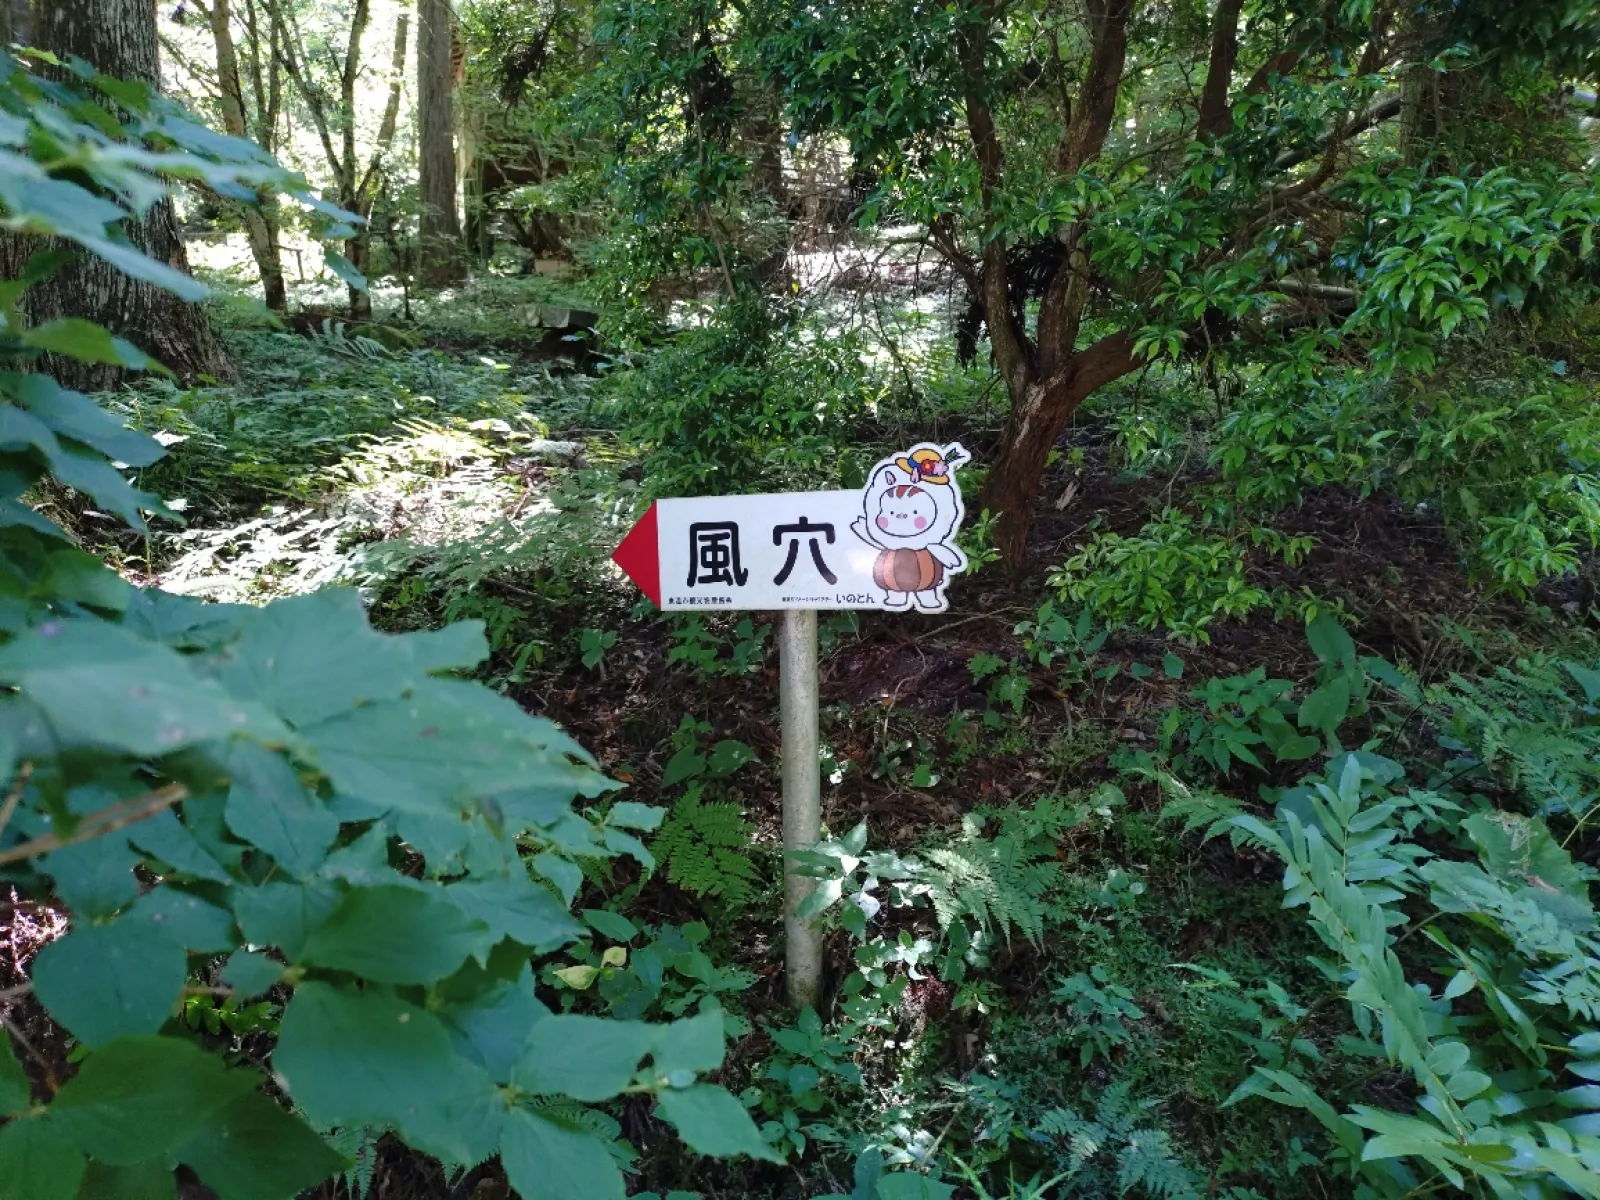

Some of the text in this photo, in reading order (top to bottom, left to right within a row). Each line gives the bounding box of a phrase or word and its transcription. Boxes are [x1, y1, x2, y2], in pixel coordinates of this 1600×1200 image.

[686, 516, 837, 588] 風穴
[836, 592, 876, 604] いのとん
